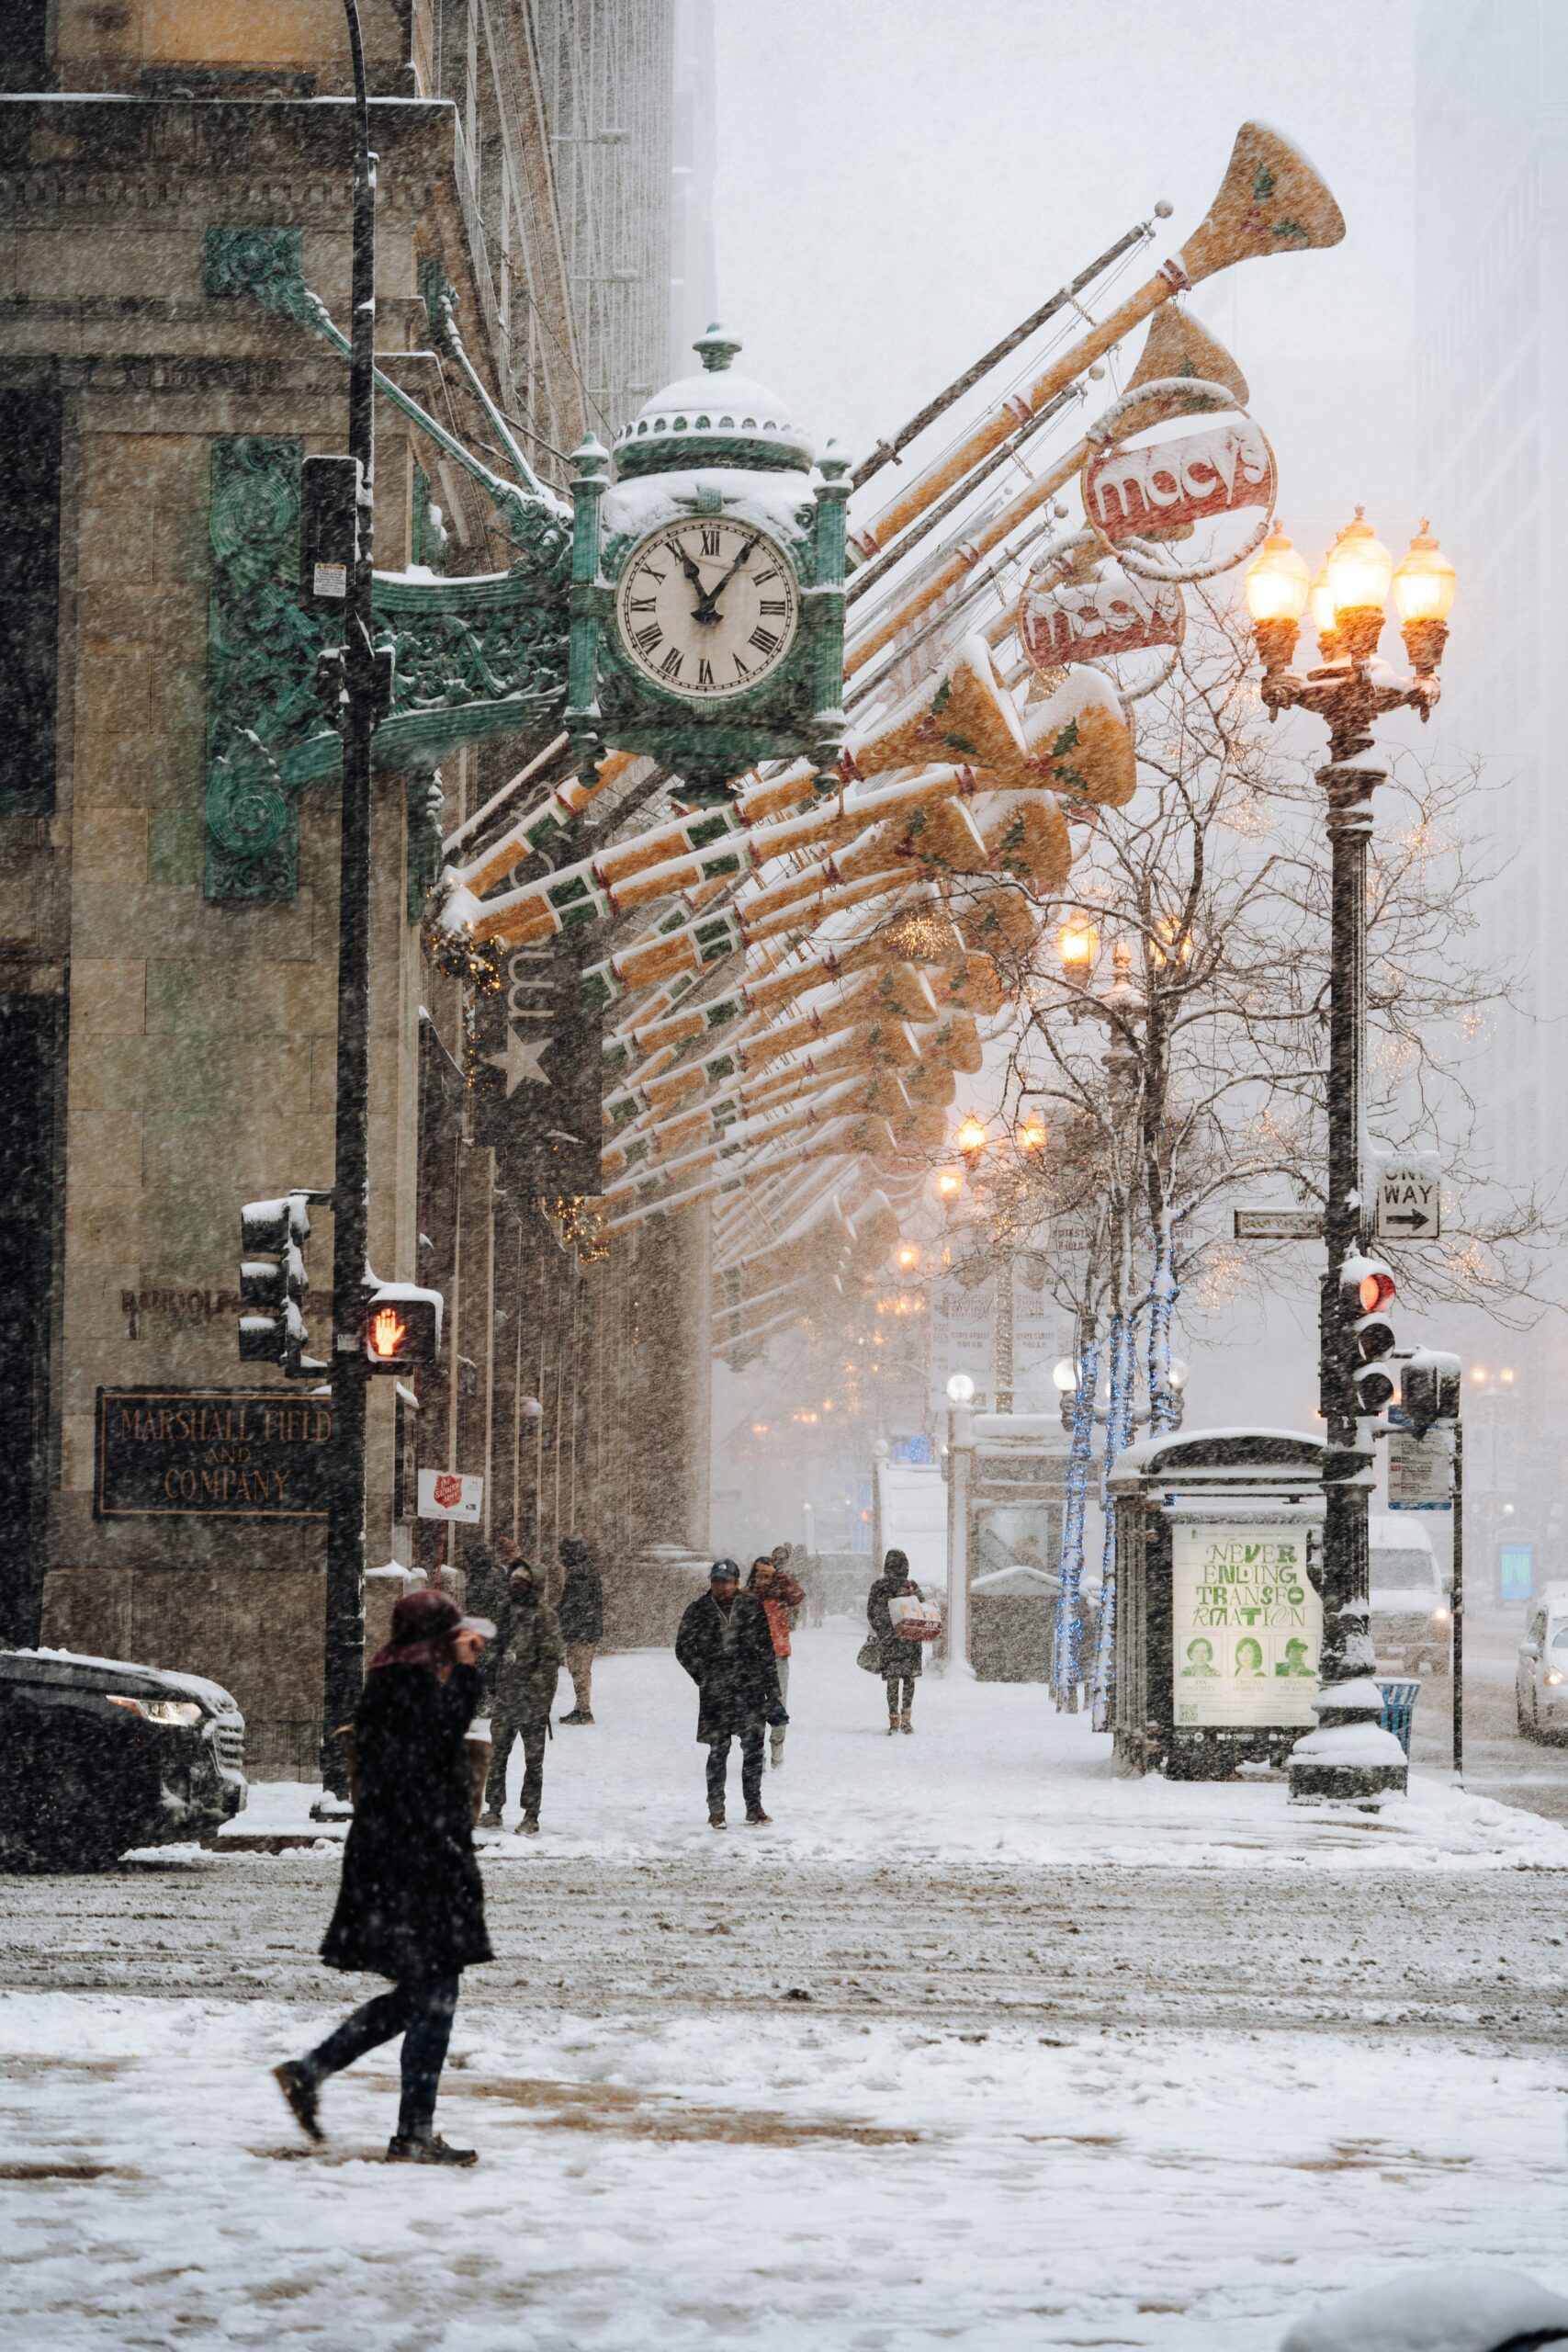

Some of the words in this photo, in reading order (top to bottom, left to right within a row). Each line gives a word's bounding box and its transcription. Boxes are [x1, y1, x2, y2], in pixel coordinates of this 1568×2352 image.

[700, 530, 721, 557] XII
[1383, 1184, 1433, 1204] WAY
[121, 1408, 254, 1442] MARSHALL
[264, 1409, 333, 1442] FIELD
[204, 1446, 252, 1463] AND
[164, 1468, 290, 1500] COMPANY
[1206, 1538, 1297, 1564] NEVER
[1203, 1566, 1297, 1584] ENDING
[1195, 1586, 1305, 1606] TRANSFO
[1192, 1607, 1305, 1627] RMATION
